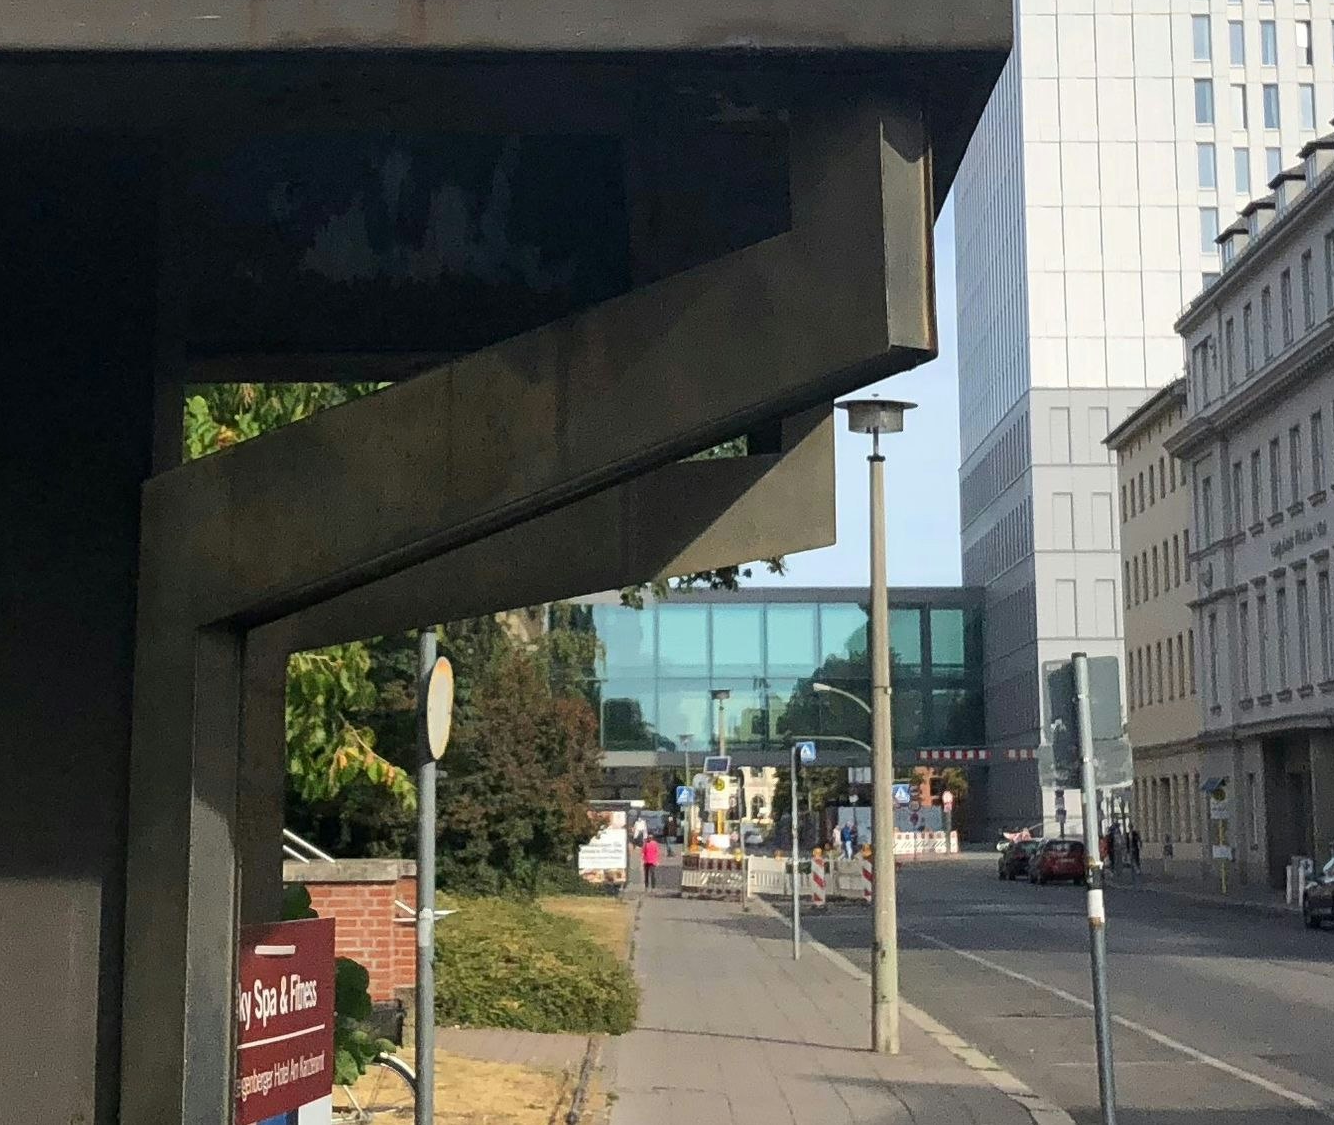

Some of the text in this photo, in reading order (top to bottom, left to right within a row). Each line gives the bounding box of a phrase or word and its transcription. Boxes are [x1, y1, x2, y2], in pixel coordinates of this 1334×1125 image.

[238, 973, 318, 1031] ky Spa & Fitness
